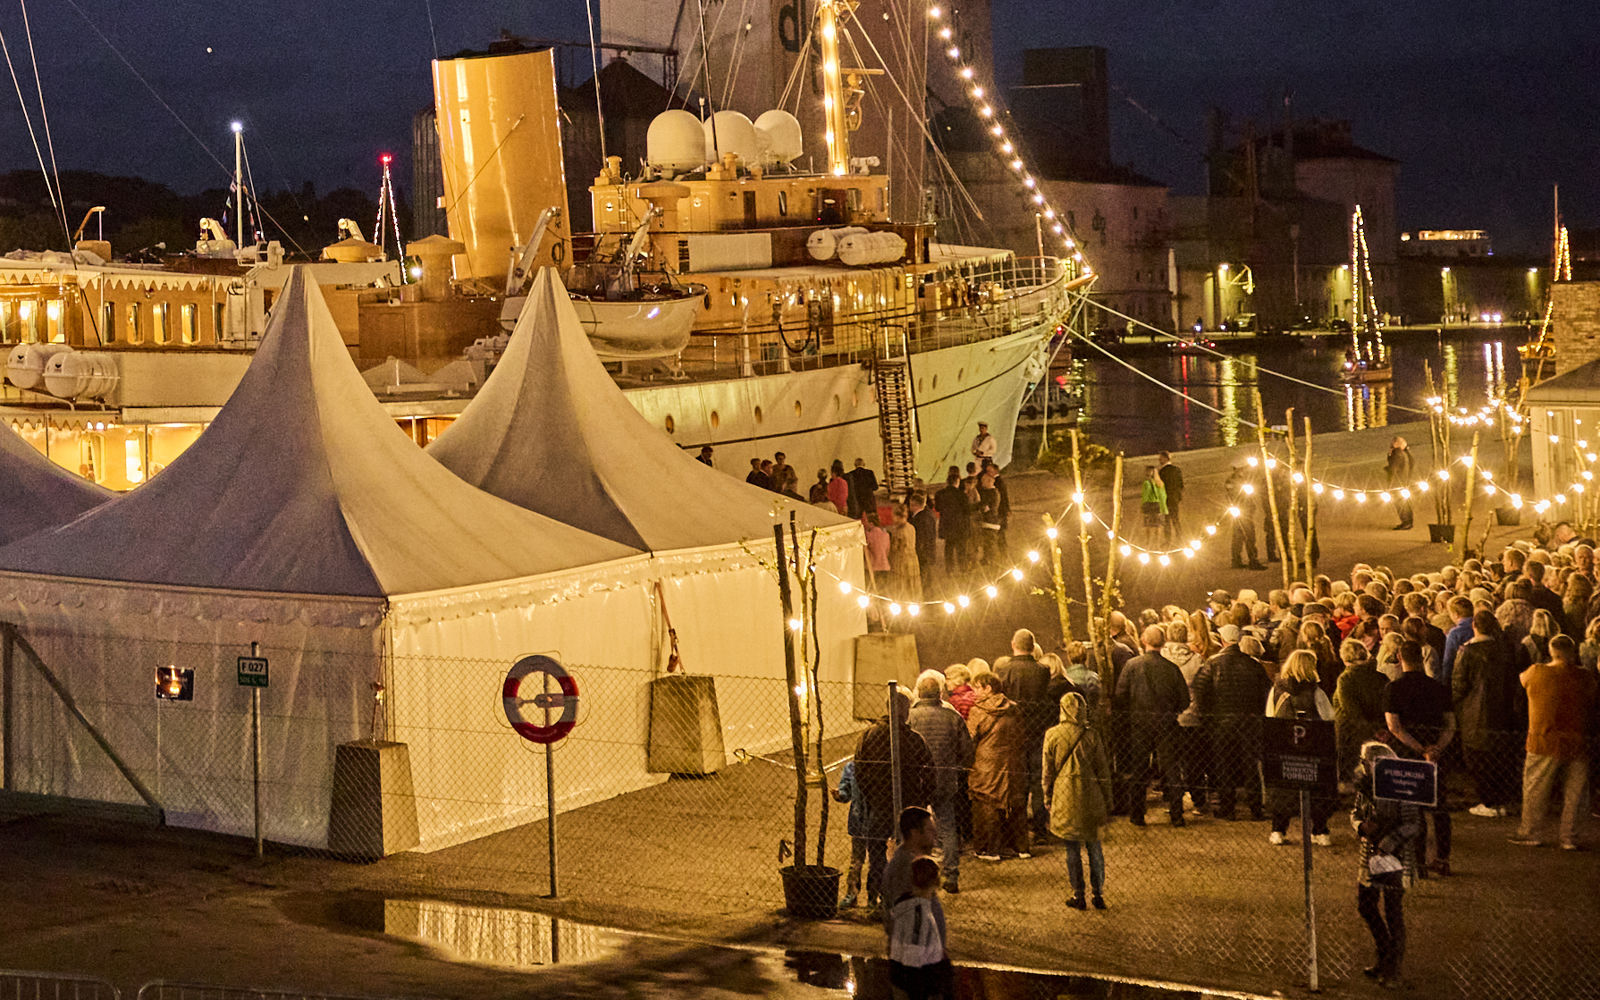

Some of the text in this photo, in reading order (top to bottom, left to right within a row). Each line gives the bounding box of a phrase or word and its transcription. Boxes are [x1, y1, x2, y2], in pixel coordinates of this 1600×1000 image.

[242, 662, 264, 673] F 027
[1293, 725, 1306, 744] P
